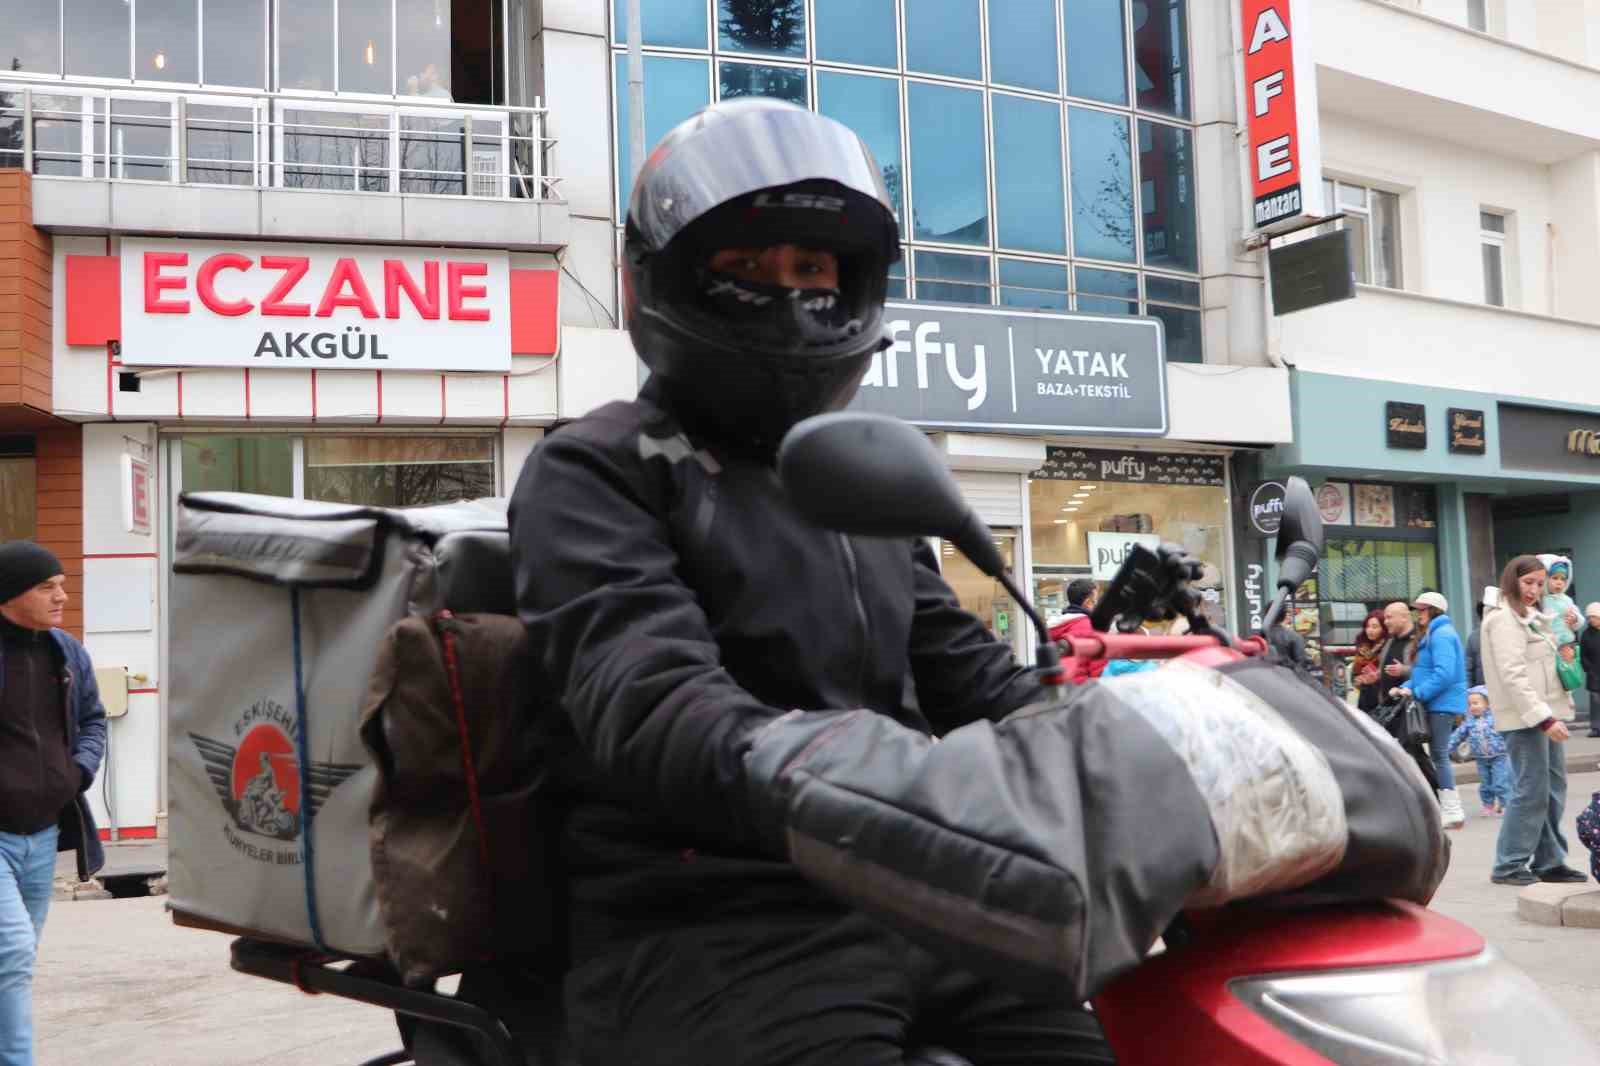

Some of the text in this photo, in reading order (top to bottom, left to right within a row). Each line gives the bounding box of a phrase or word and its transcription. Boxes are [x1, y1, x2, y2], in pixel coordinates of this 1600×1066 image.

[752, 193, 846, 213] LS2
[1255, 189, 1300, 223] manzara
[144, 252, 490, 321] ECZANE
[254, 326, 389, 360] AKGÜL
[1035, 348, 1129, 378] YATAK
[1101, 456, 1145, 479] puffy
[1244, 564, 1264, 629] puffy
